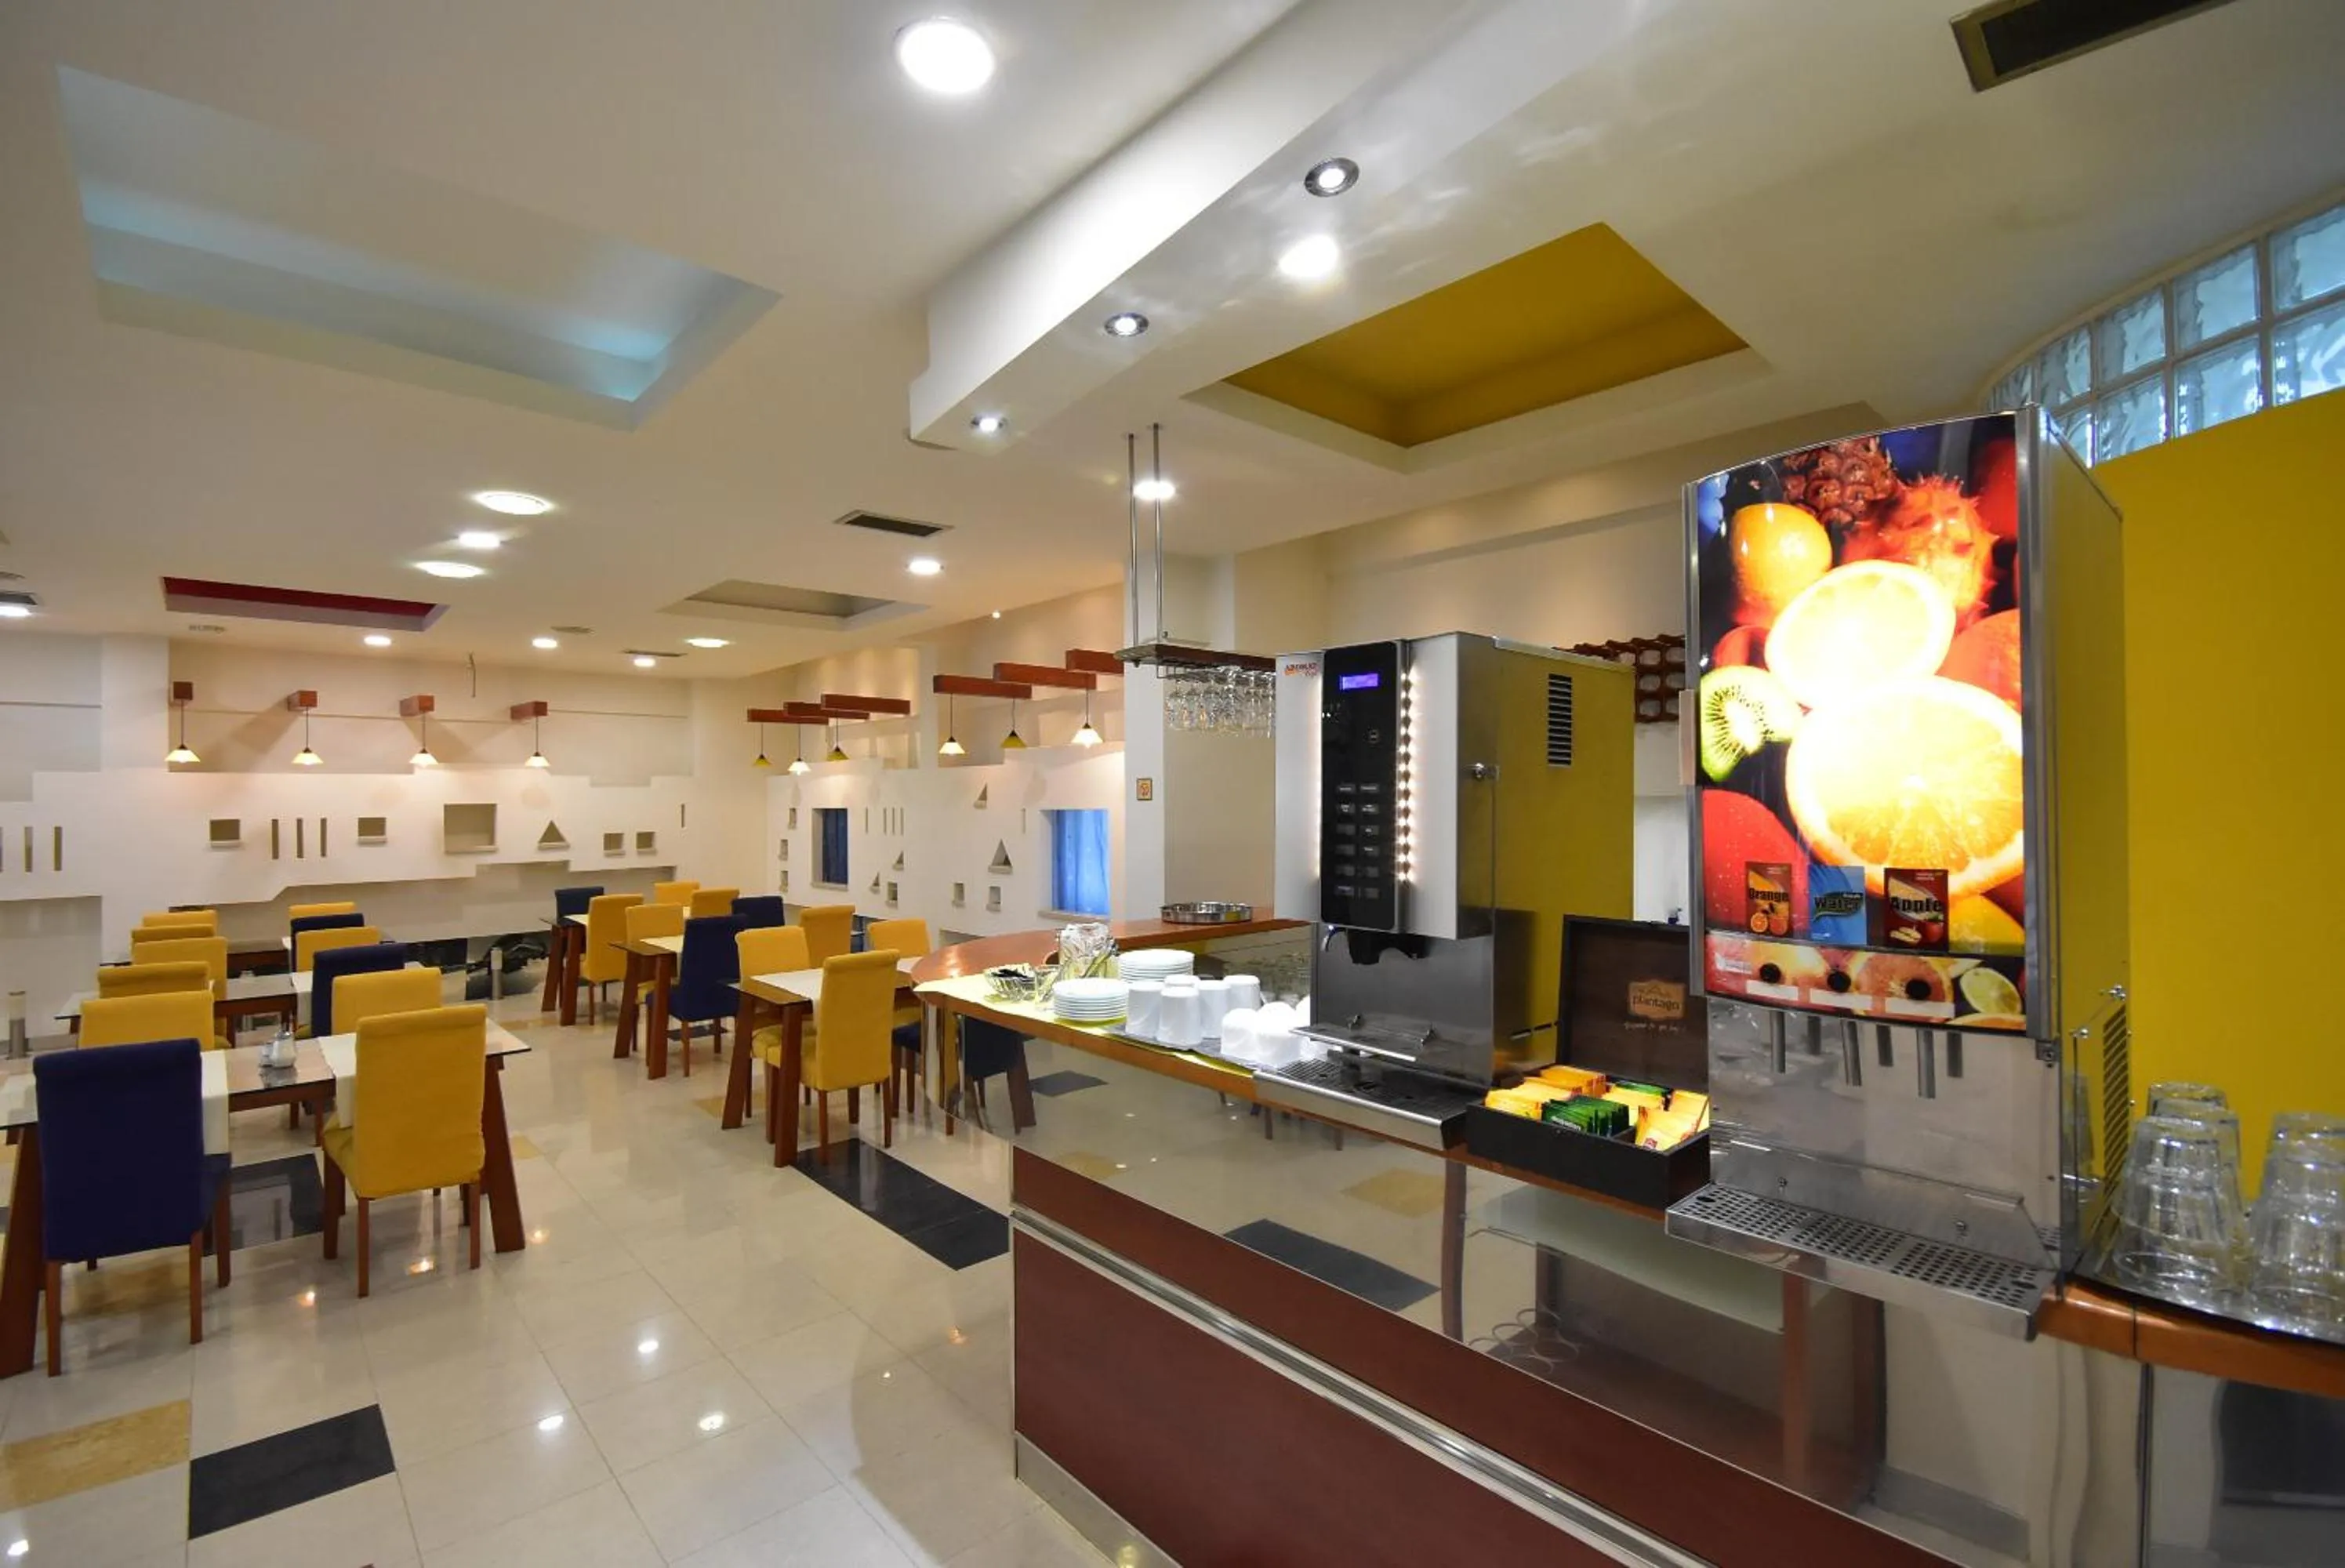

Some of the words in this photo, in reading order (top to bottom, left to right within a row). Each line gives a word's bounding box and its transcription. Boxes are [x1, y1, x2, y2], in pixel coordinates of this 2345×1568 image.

[1748, 887, 1789, 902] Orange
[1814, 896, 1861, 912] Water
[1890, 896, 1944, 913] Apple
